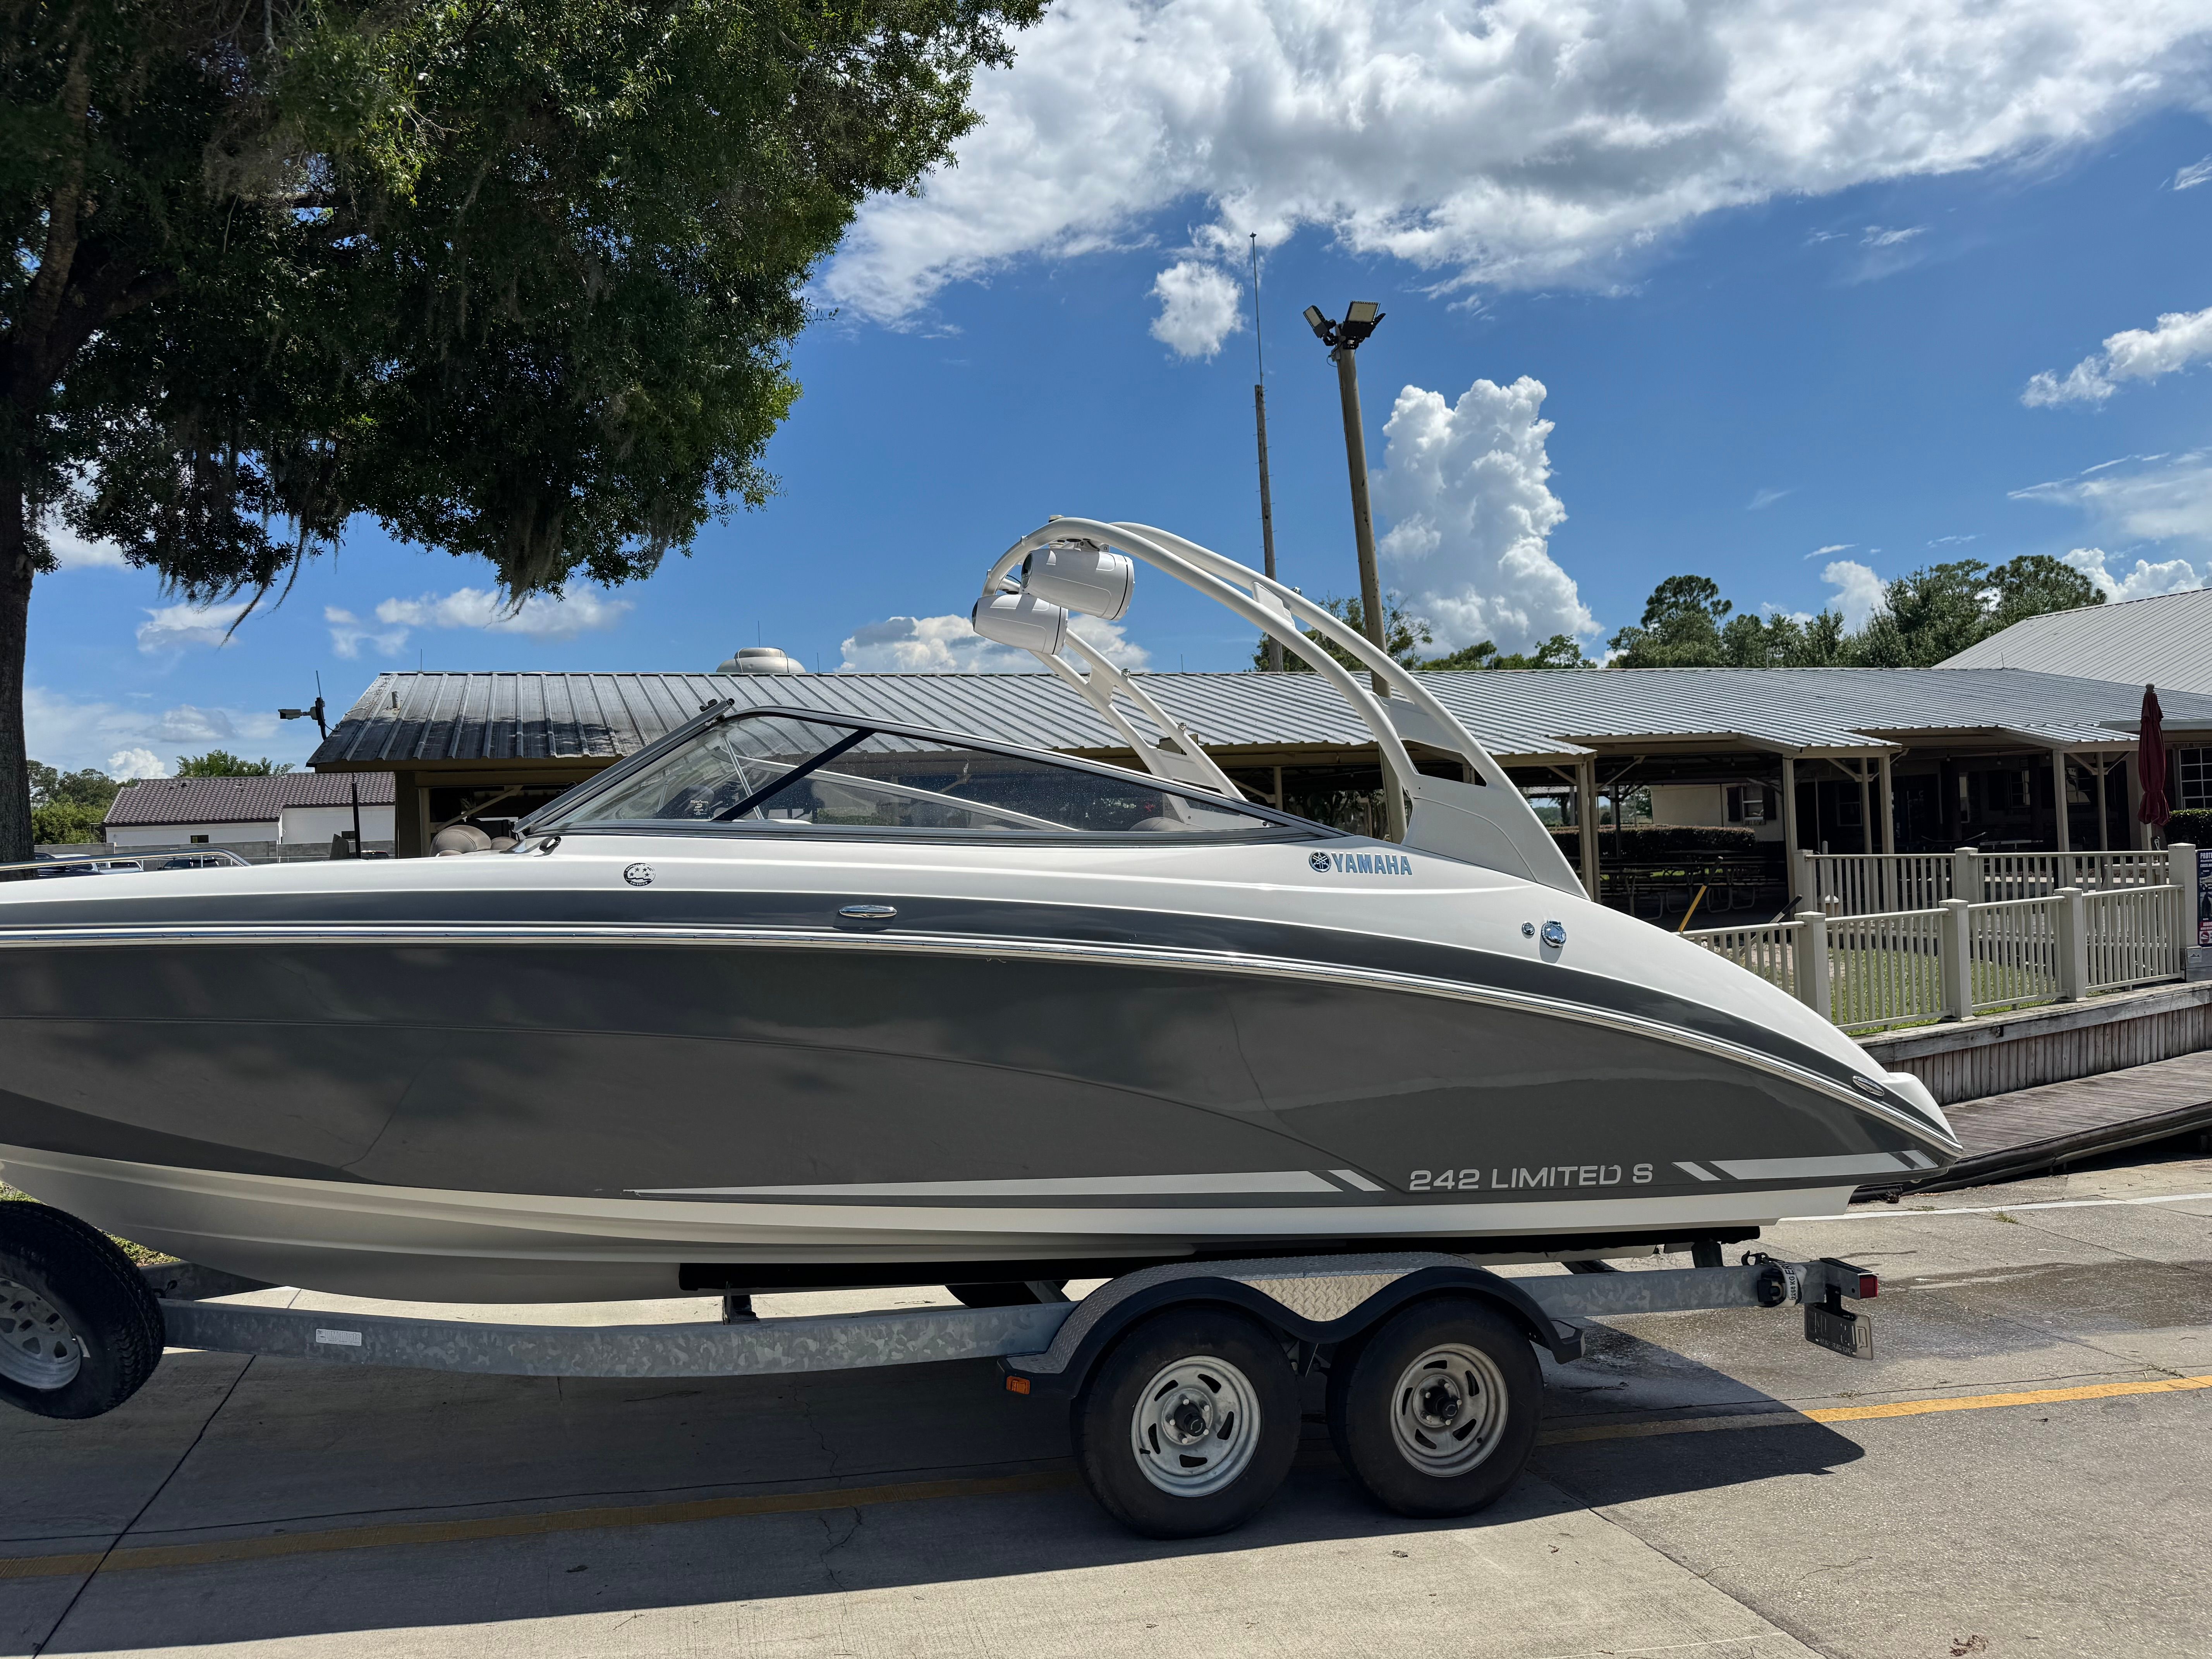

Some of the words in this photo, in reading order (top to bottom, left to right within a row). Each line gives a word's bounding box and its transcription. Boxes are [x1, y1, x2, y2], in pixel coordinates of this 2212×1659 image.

[1331, 852, 1413, 875] YAMAHA
[1410, 1169, 1480, 1190] 242
[1491, 1165, 1621, 1188] LIMITED
[1633, 1163, 1653, 1183] S
[1789, 1276, 1795, 1285] KG
